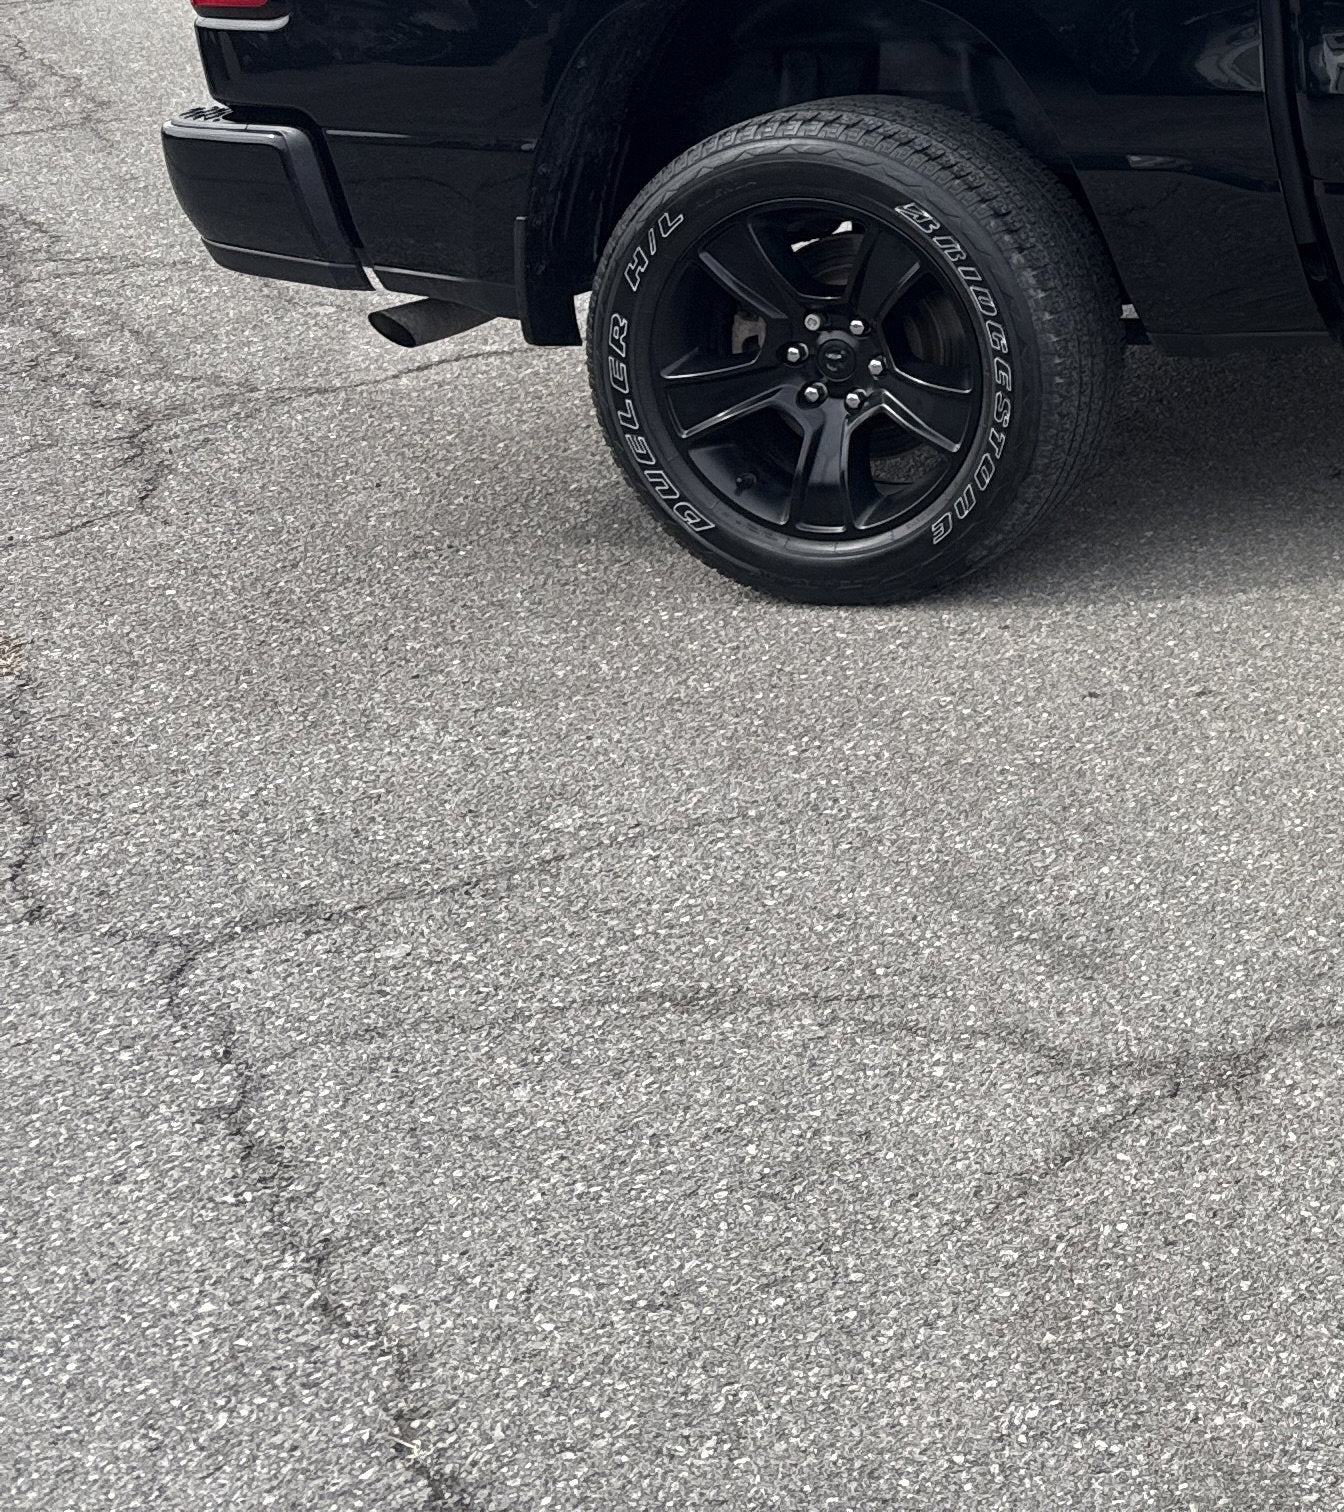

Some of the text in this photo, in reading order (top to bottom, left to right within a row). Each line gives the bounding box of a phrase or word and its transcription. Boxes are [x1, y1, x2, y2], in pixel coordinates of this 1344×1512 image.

[608, 210, 715, 533] DUELER H/L
[894, 202, 1013, 545] BRIDGESTONE
